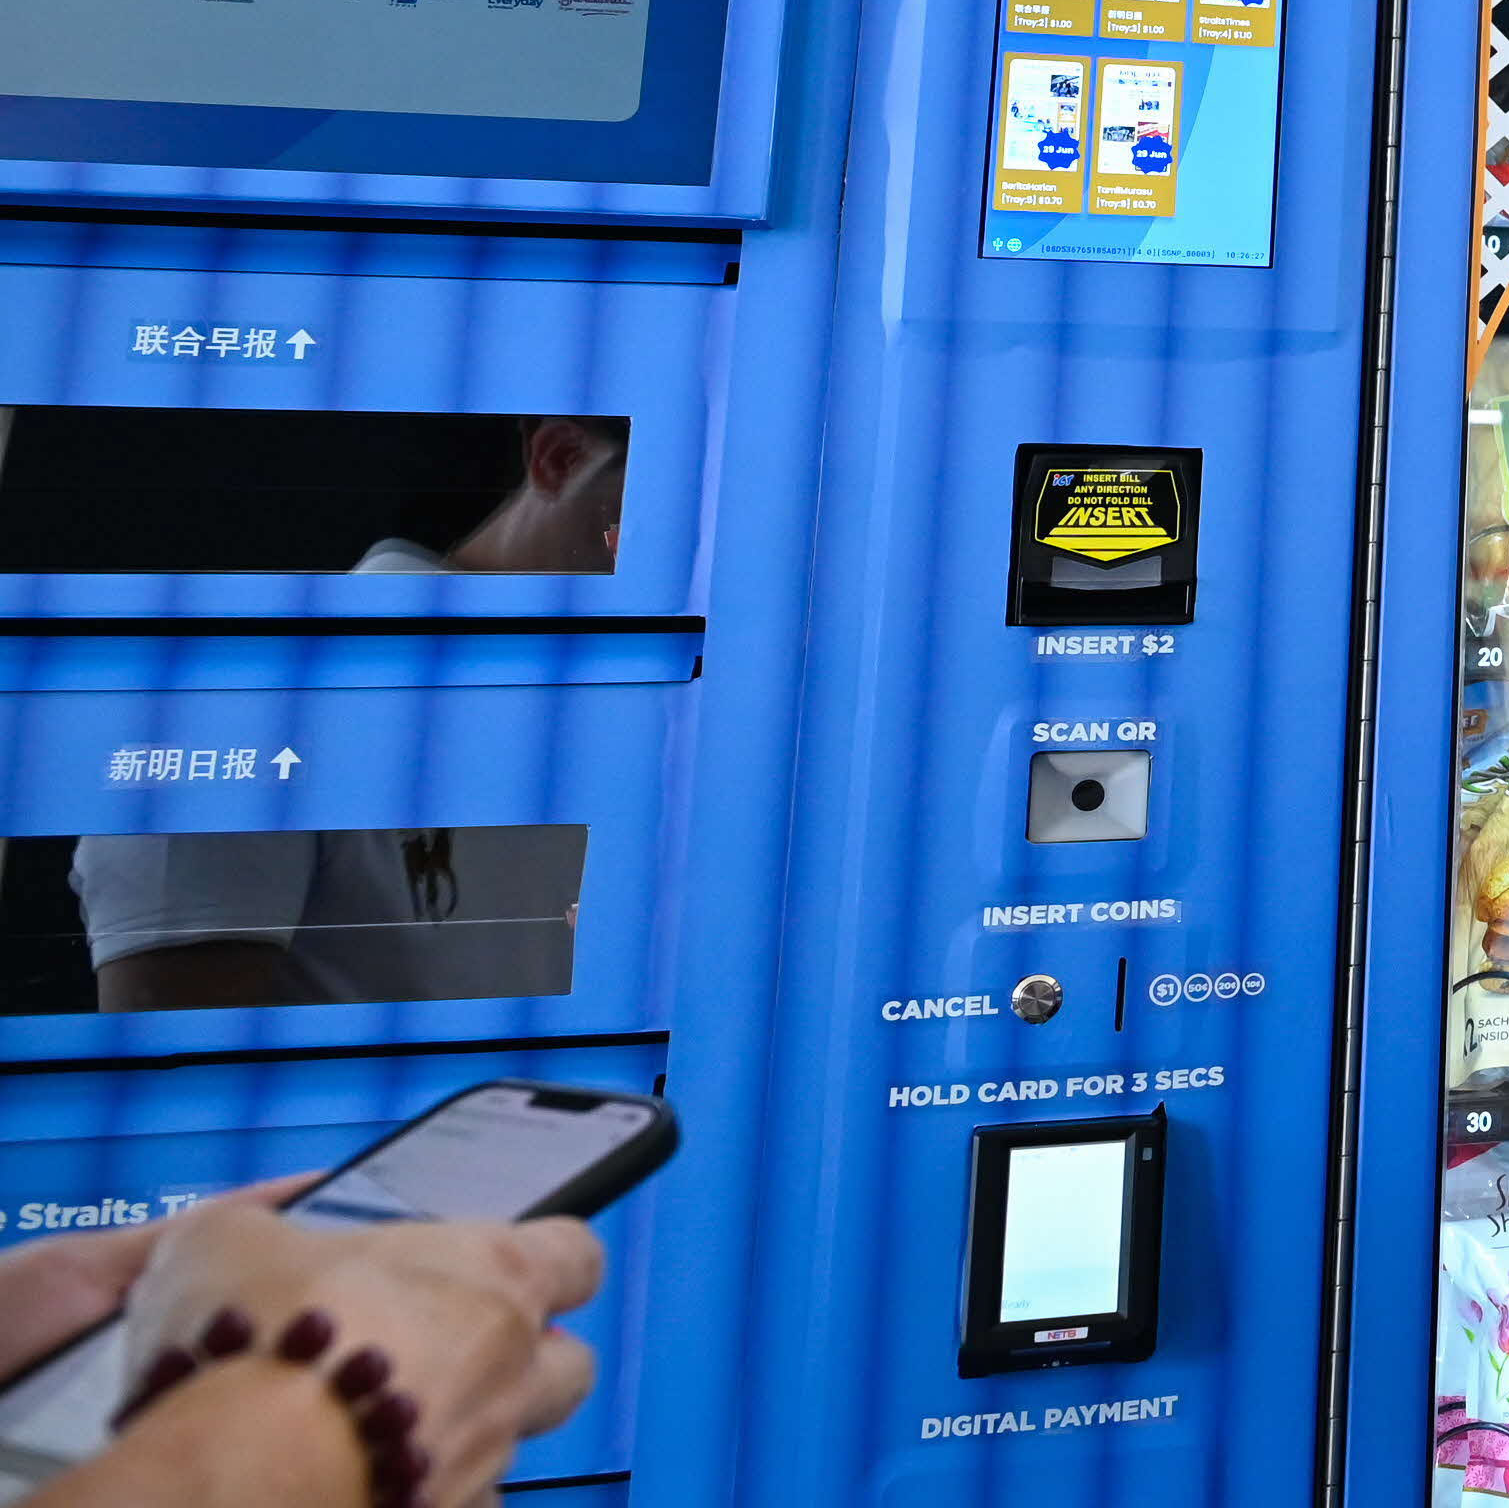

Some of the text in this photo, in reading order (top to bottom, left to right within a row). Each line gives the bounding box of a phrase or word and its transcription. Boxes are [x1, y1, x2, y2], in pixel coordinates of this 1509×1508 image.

[132, 324, 278, 360] 联合早报
[1074, 485, 1148, 494] ANY DIRECTION
[1083, 474, 1141, 483] INSERT BILL
[1067, 496, 1153, 505] DO NOT FOLD BILL
[1057, 506, 1155, 526] INSERT
[1036, 634, 1176, 657] INSERT $2
[1477, 647, 1503, 668] 20
[1032, 721, 1158, 743] SCAN QR
[108, 748, 257, 782] 新明日报
[982, 898, 1177, 927] INSERT COINS
[880, 995, 1000, 1022] CANCEL
[888, 1064, 1225, 1109] HOLD CARD FOR 3 SECS
[1466, 1110, 1493, 1133] 30
[20, 1195, 149, 1232] Straits
[920, 1394, 1179, 1440] DIGITAL PAYMENT
